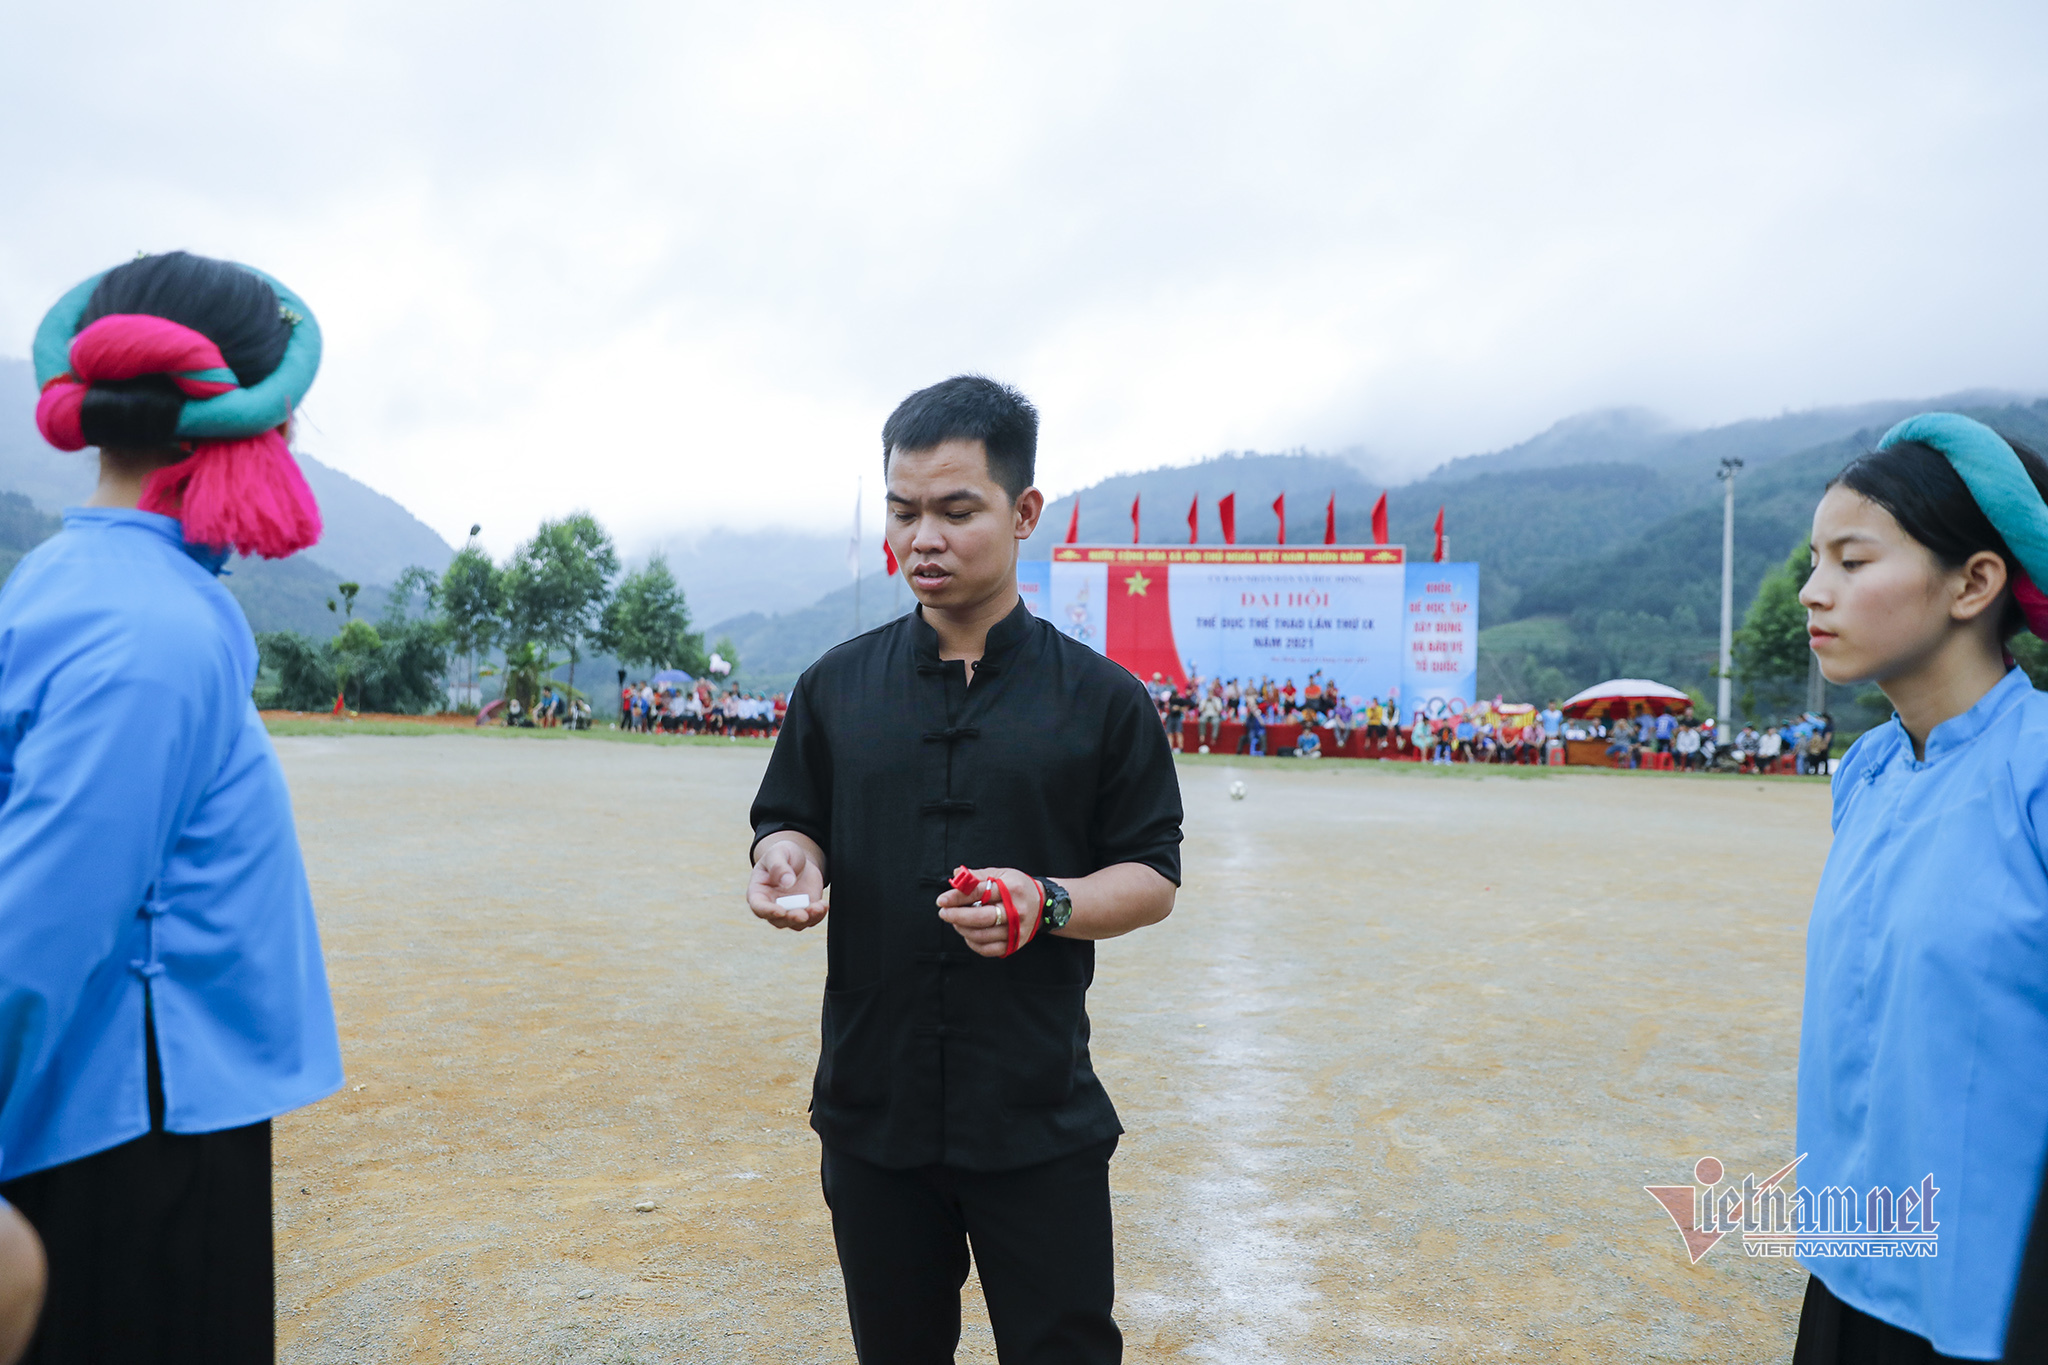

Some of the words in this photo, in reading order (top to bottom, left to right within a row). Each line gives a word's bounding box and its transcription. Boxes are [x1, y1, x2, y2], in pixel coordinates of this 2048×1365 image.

[1258, 550, 1279, 563] VIỆT
[1281, 551, 1306, 562] NAM
[1241, 592, 1279, 611] ĐẠI
[1288, 588, 1329, 611] HỘI
[1222, 618, 1243, 631] DỤC
[1276, 618, 1304, 629] THAO
[1254, 636, 1280, 649] NĂM
[1286, 638, 1313, 649] 2021
